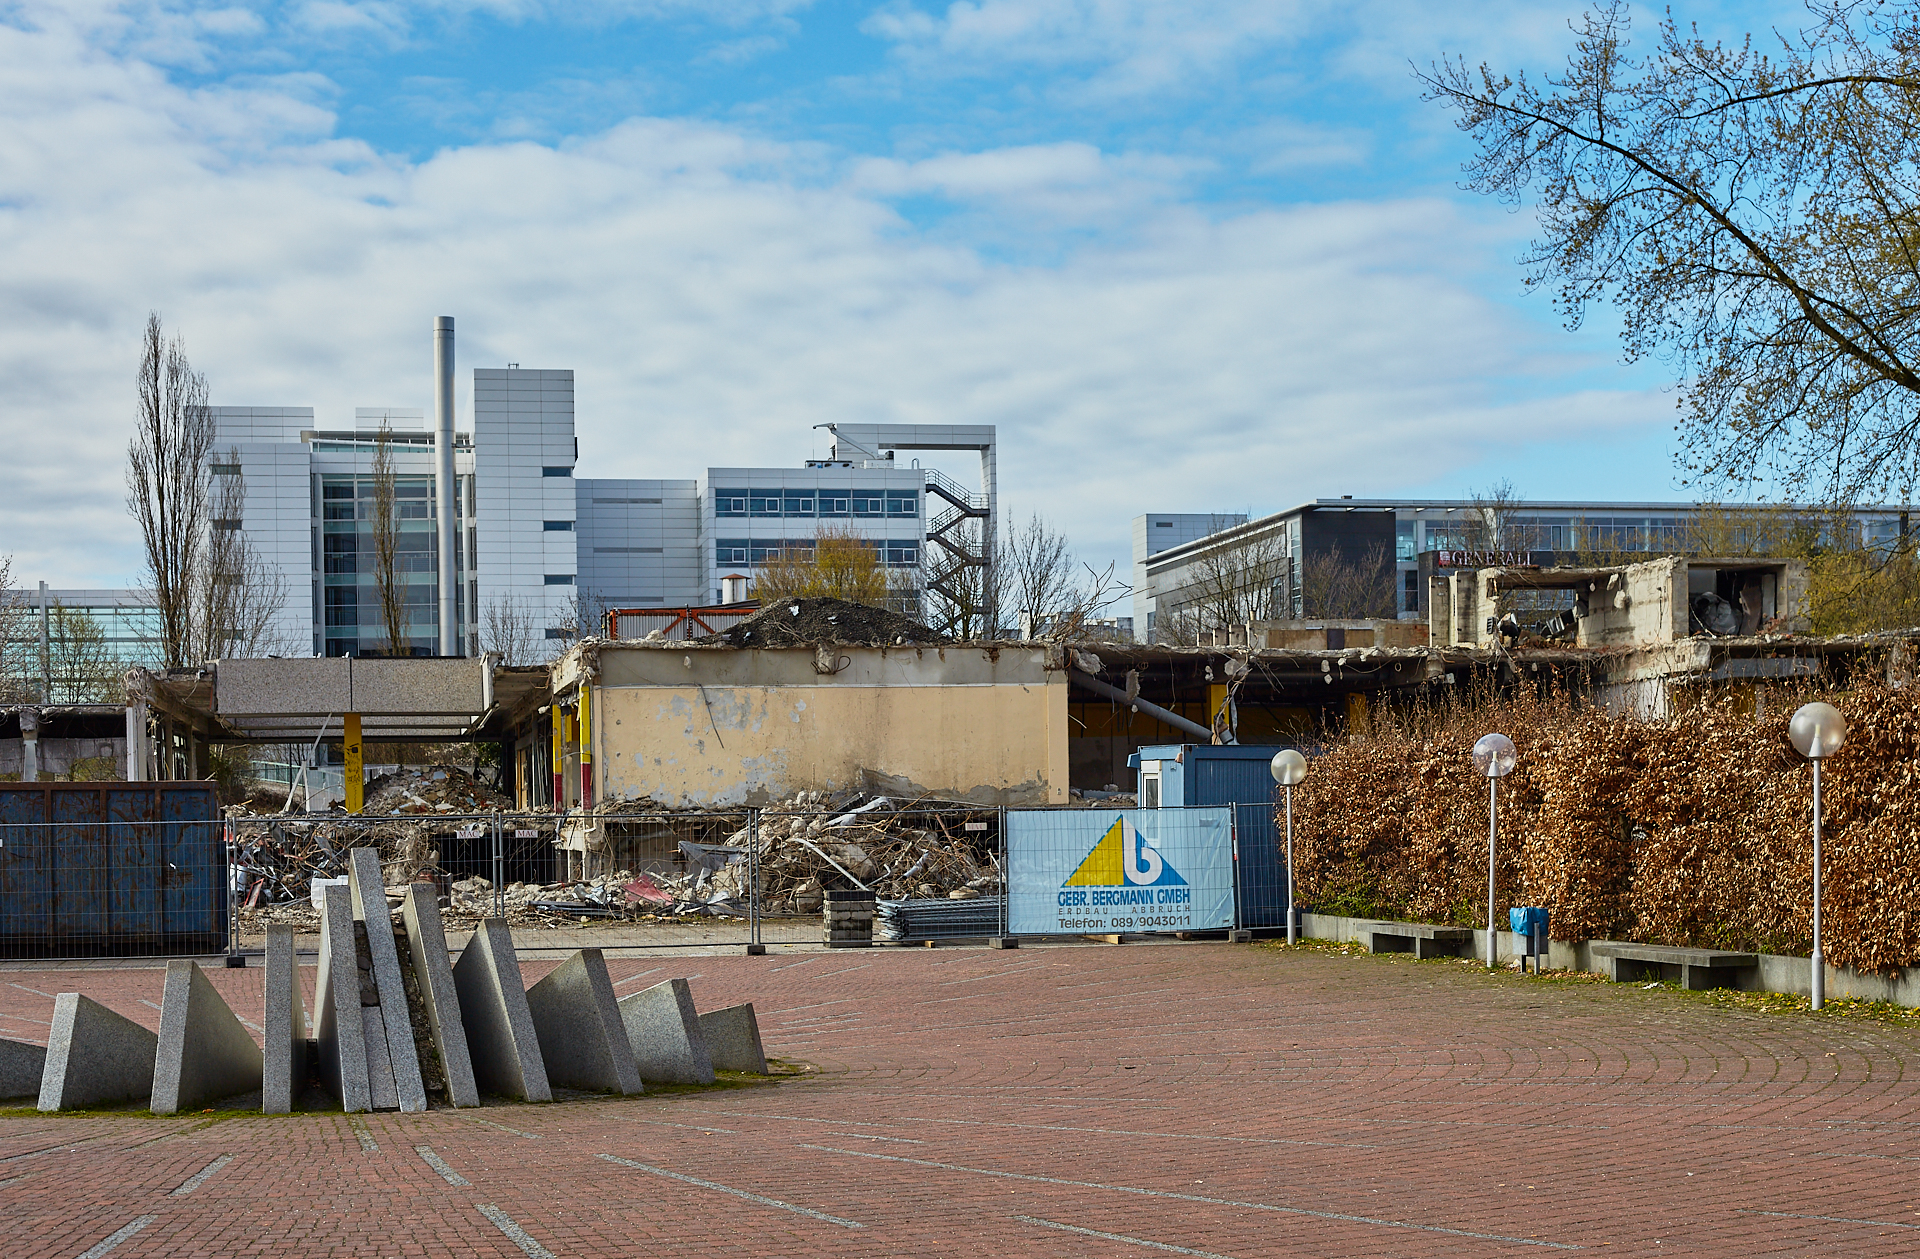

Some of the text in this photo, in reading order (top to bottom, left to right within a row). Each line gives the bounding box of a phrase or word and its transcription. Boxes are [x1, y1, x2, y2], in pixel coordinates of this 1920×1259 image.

[1452, 550, 1531, 566] GENERALI
[459, 830, 478, 838] MAC
[1058, 888, 1190, 906] GEBR. BERGMANN GMBH
[1058, 907, 1108, 915] ERDBAU
[1131, 905, 1190, 914] ABBRUCH
[1058, 915, 1190, 928] Telefon: 089/9043011
